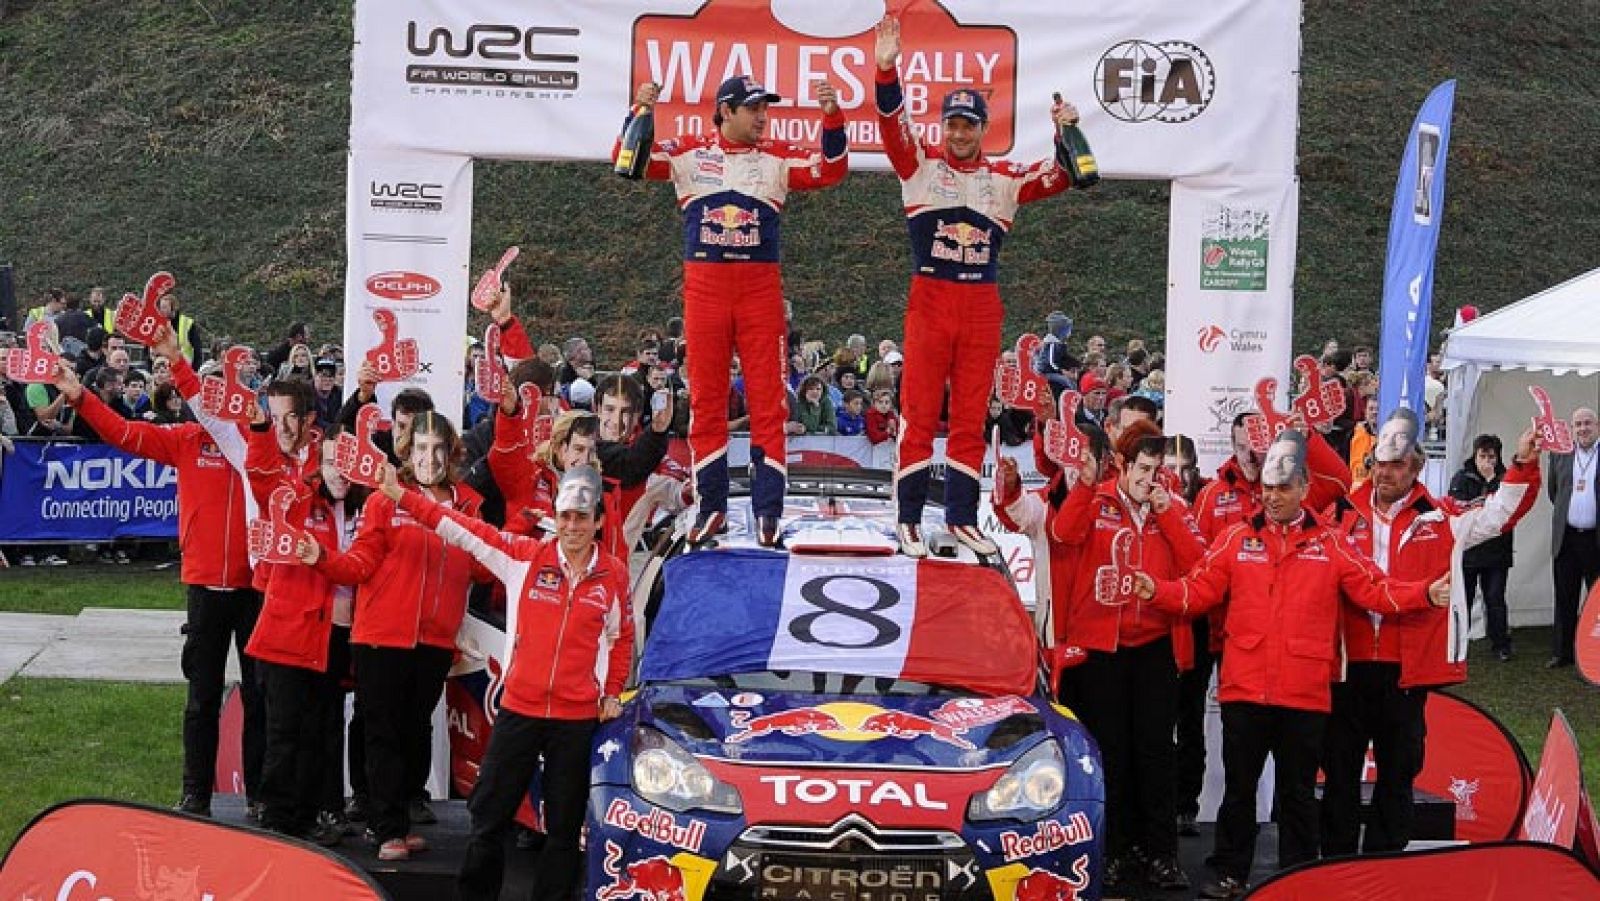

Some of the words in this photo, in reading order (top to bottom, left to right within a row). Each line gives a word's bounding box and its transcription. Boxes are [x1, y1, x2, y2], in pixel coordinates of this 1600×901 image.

[408, 21, 579, 63] WRC
[409, 69, 437, 80] FIA
[441, 71, 508, 83] WORLD
[512, 74, 574, 86] RALLY
[896, 51, 1000, 84] ALLY
[409, 86, 574, 99] CHAMPIONSHIP
[370, 180, 444, 200] WRC
[374, 280, 433, 293] DELPHI
[139, 316, 155, 335] 8
[1230, 328, 1268, 342] Cymru
[1230, 341, 1263, 352] Wales
[34, 358, 48, 374] 8
[377, 353, 391, 373] 8
[1023, 379, 1037, 400] 8
[228, 393, 244, 414] 8
[1306, 398, 1320, 418] 8
[1069, 437, 1080, 458] 8
[44, 458, 178, 490] NOKIA
[359, 453, 373, 476] 8
[41, 496, 130, 522] Connecting
[134, 495, 178, 521] Peopl
[279, 533, 292, 555] 8
[1121, 575, 1132, 596] 8
[788, 574, 902, 649] 8
[759, 775, 949, 810] TOTAL
[605, 799, 657, 839] Red
[655, 810, 707, 852] Bull
[1000, 821, 1046, 862] Red
[1045, 811, 1093, 852] Bull
